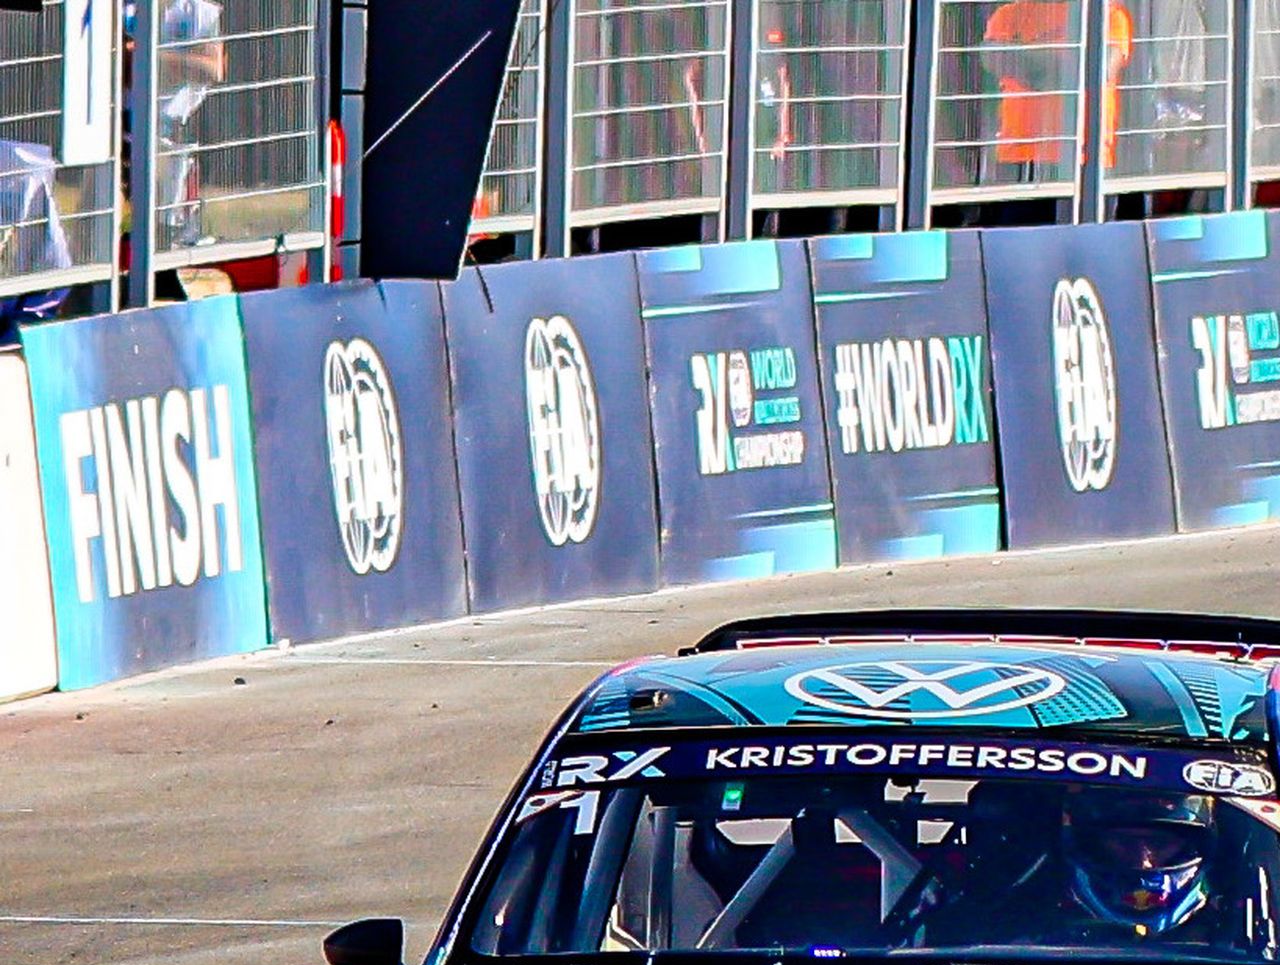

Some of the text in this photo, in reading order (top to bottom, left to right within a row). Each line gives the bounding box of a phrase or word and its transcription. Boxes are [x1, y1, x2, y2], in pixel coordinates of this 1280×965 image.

[834, 335, 989, 454] #WORLDRX
[61, 384, 242, 602] FINISH
[557, 747, 671, 786] RX
[706, 744, 1147, 780] KRISTOFFERSSON
[1186, 763, 1271, 794] FIA
[560, 790, 601, 835] 1
